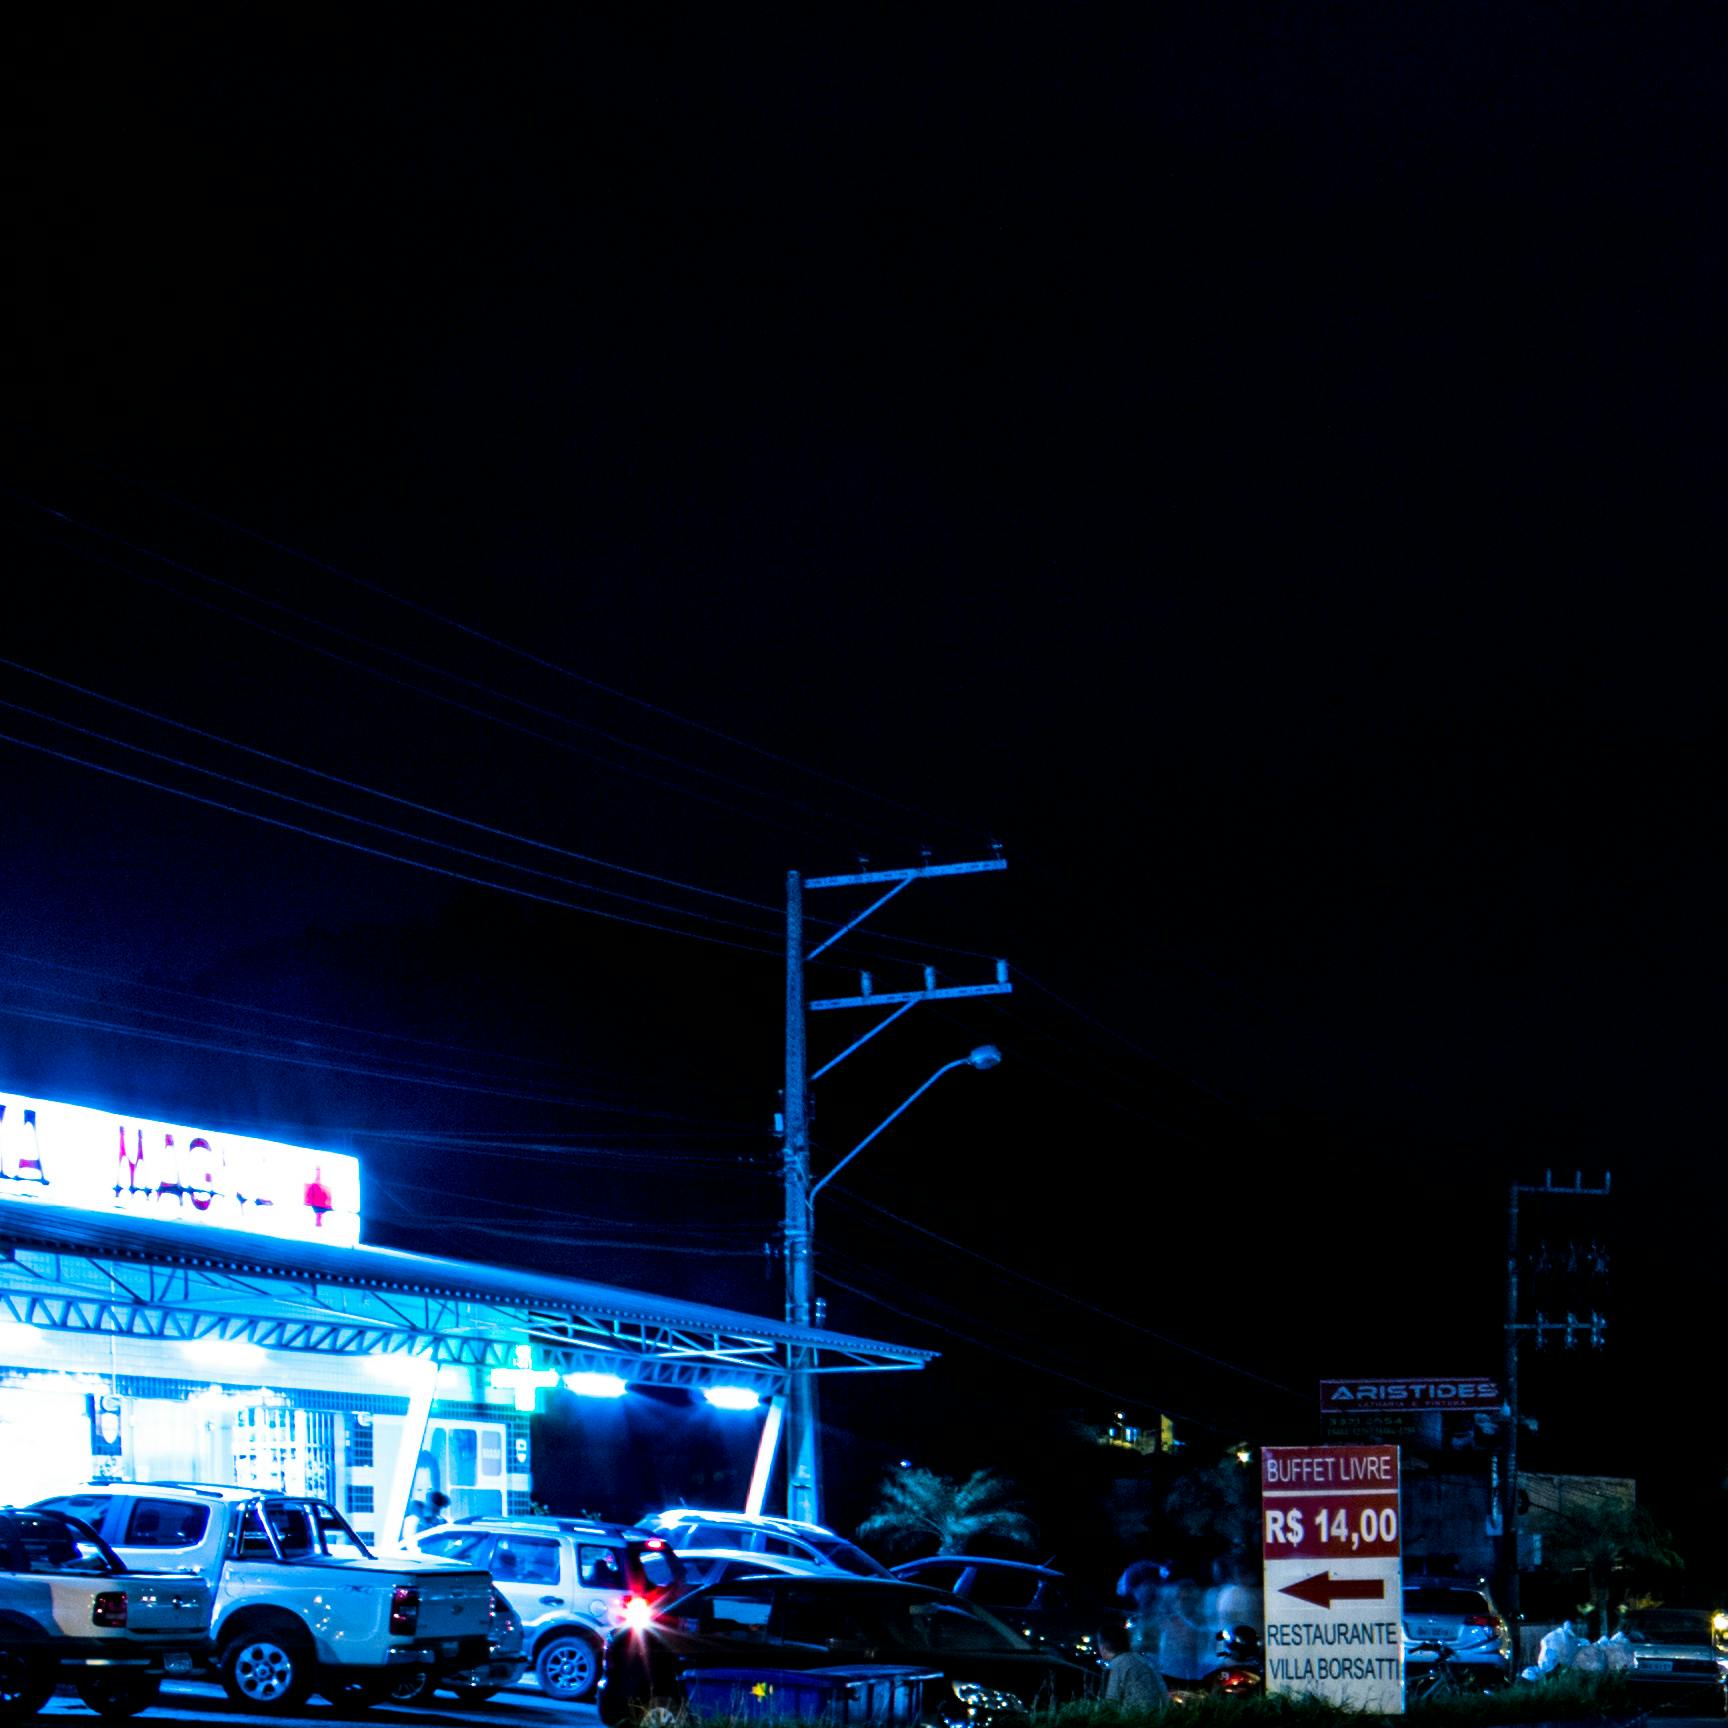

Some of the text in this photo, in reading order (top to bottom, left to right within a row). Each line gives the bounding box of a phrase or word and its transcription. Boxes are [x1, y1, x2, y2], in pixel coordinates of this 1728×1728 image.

[1330, 1382, 1499, 1401] ARISTIDES
[1267, 1456, 1392, 1482] BUFFET LIVRE
[1265, 1507, 1397, 1550] R$ 14,00
[1267, 1623, 1398, 1646] RESTAURANTE
[1269, 1657, 1400, 1680] VILLA BORSATTI
